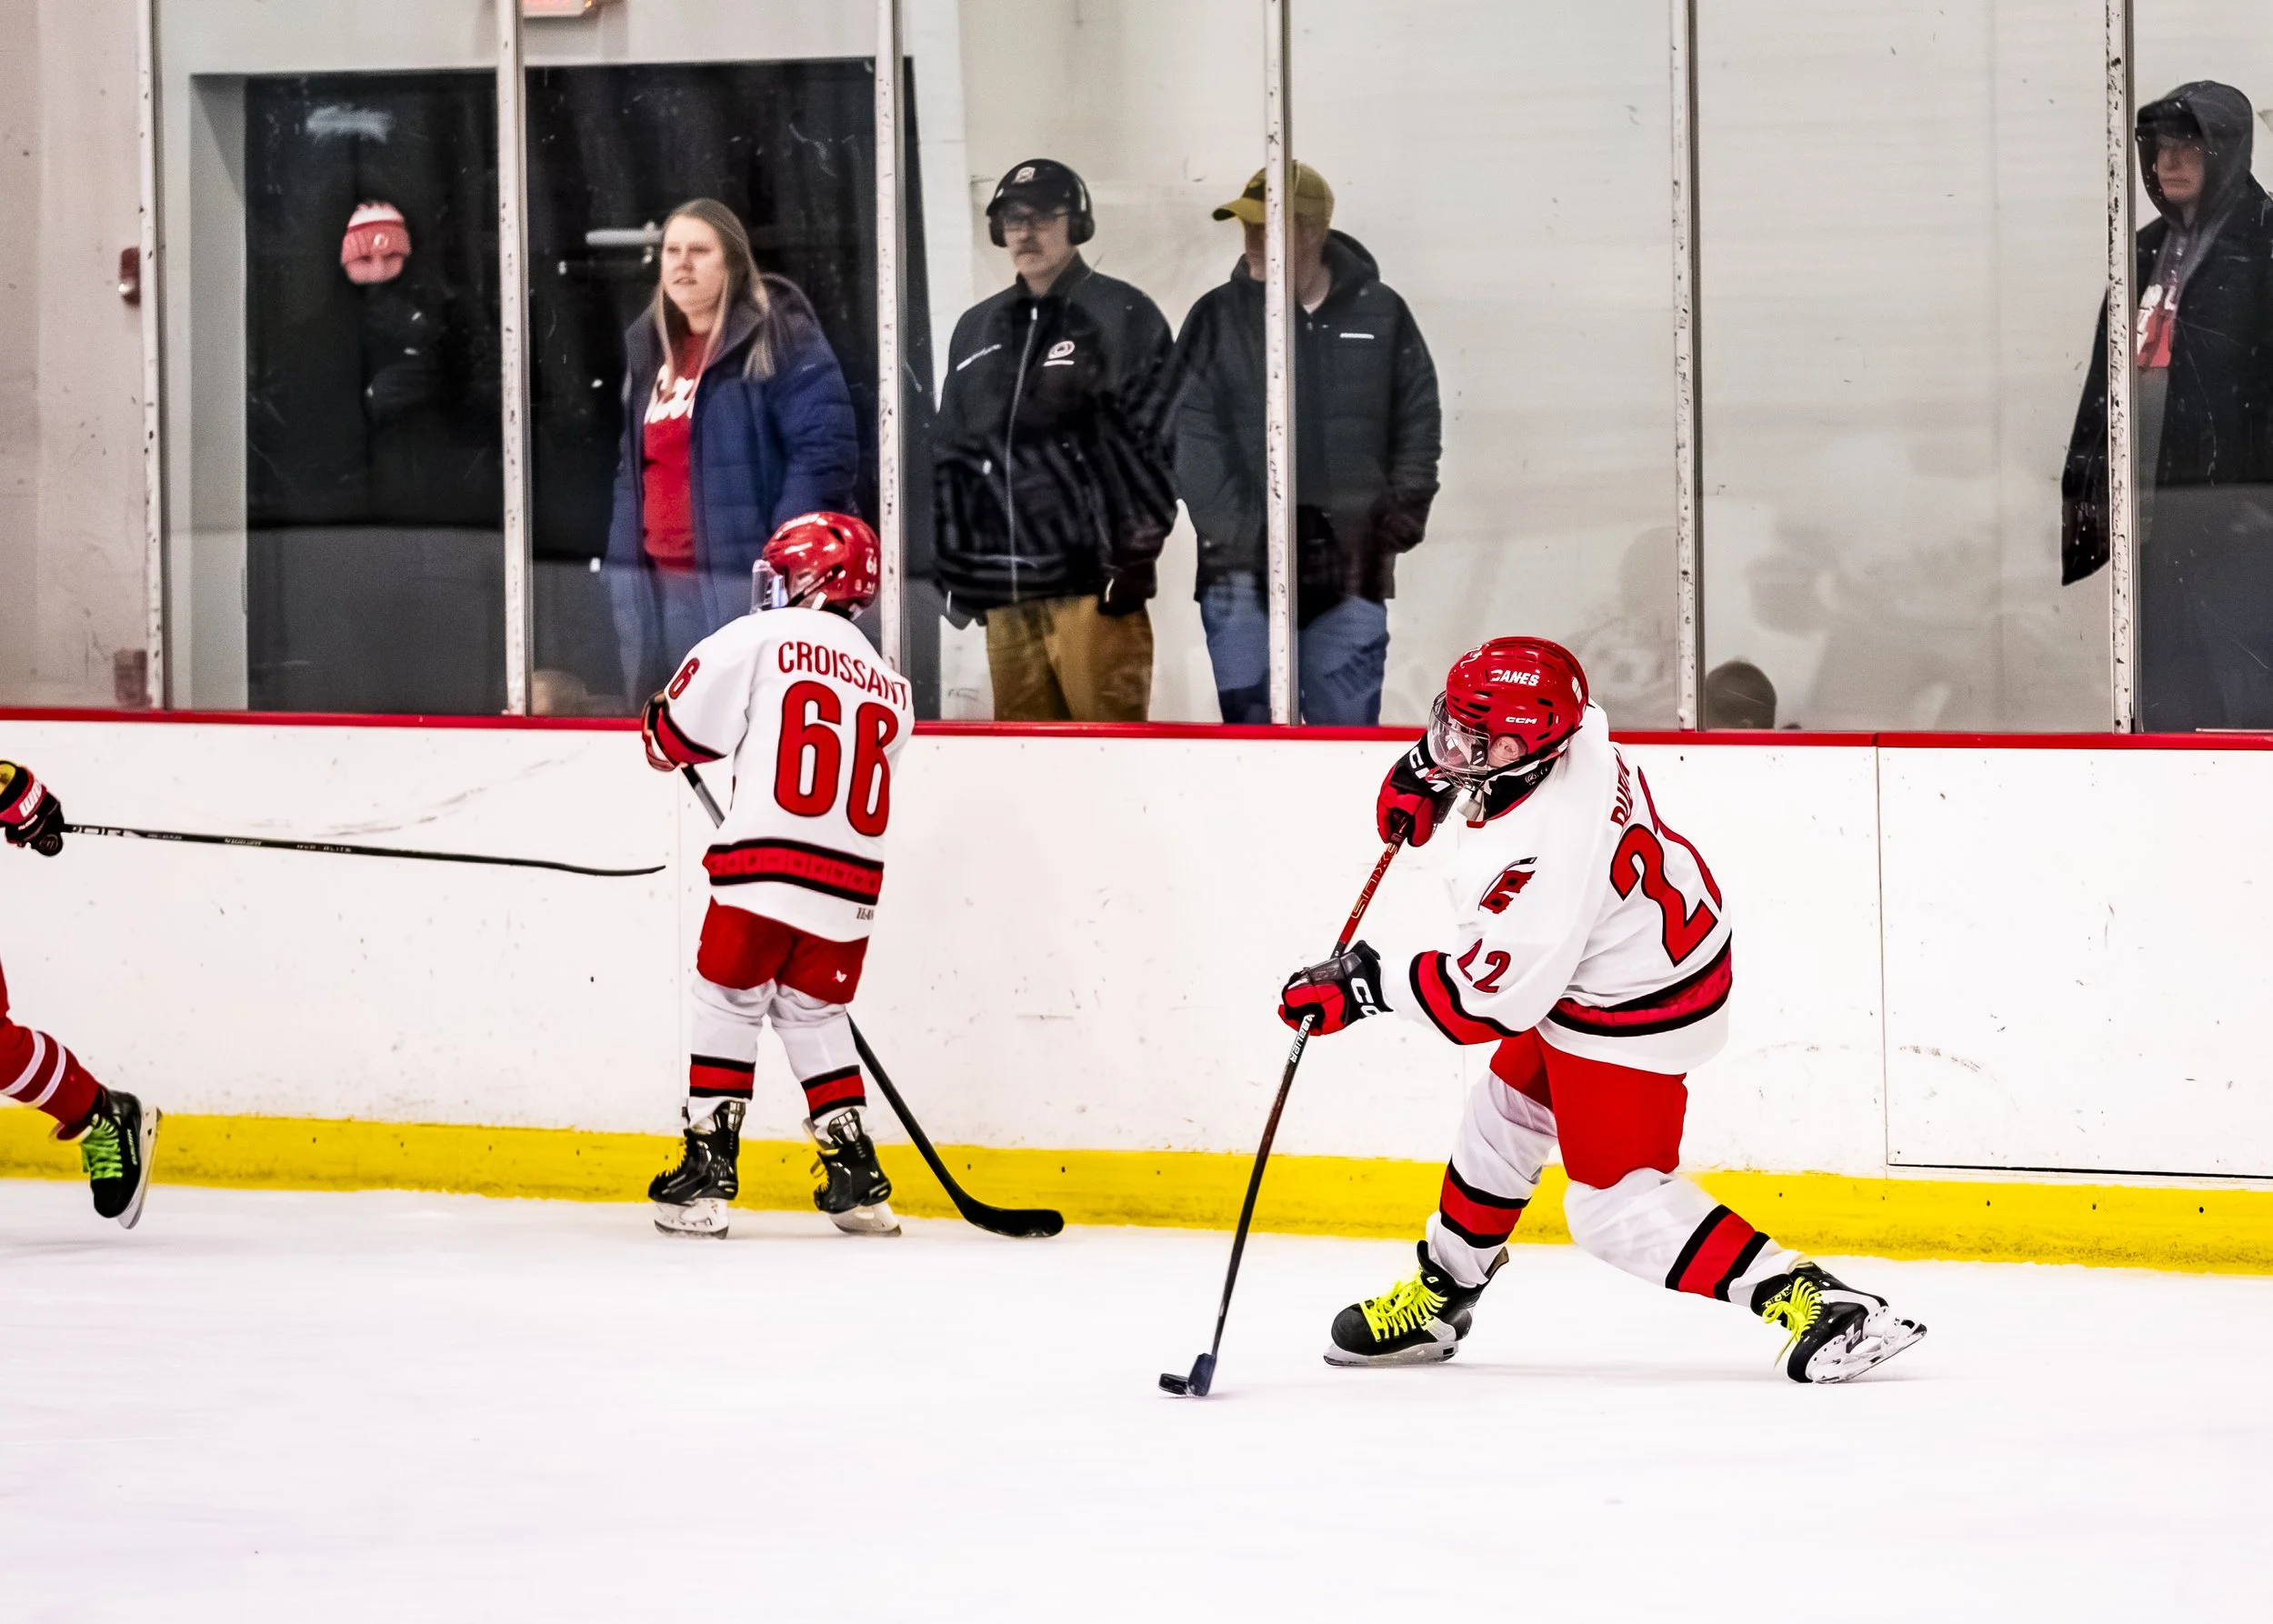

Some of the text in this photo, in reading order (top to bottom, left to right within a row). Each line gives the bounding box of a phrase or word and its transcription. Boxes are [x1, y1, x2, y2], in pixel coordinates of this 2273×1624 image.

[777, 641, 909, 710] CROISSANT
[1490, 668, 1540, 687] CANES
[1506, 716, 1537, 724] CCM
[774, 680, 899, 837] 66
[1409, 747, 1451, 793] CM
[1350, 977, 1381, 1017] CC
[1289, 1018, 1311, 1064] BAUER
